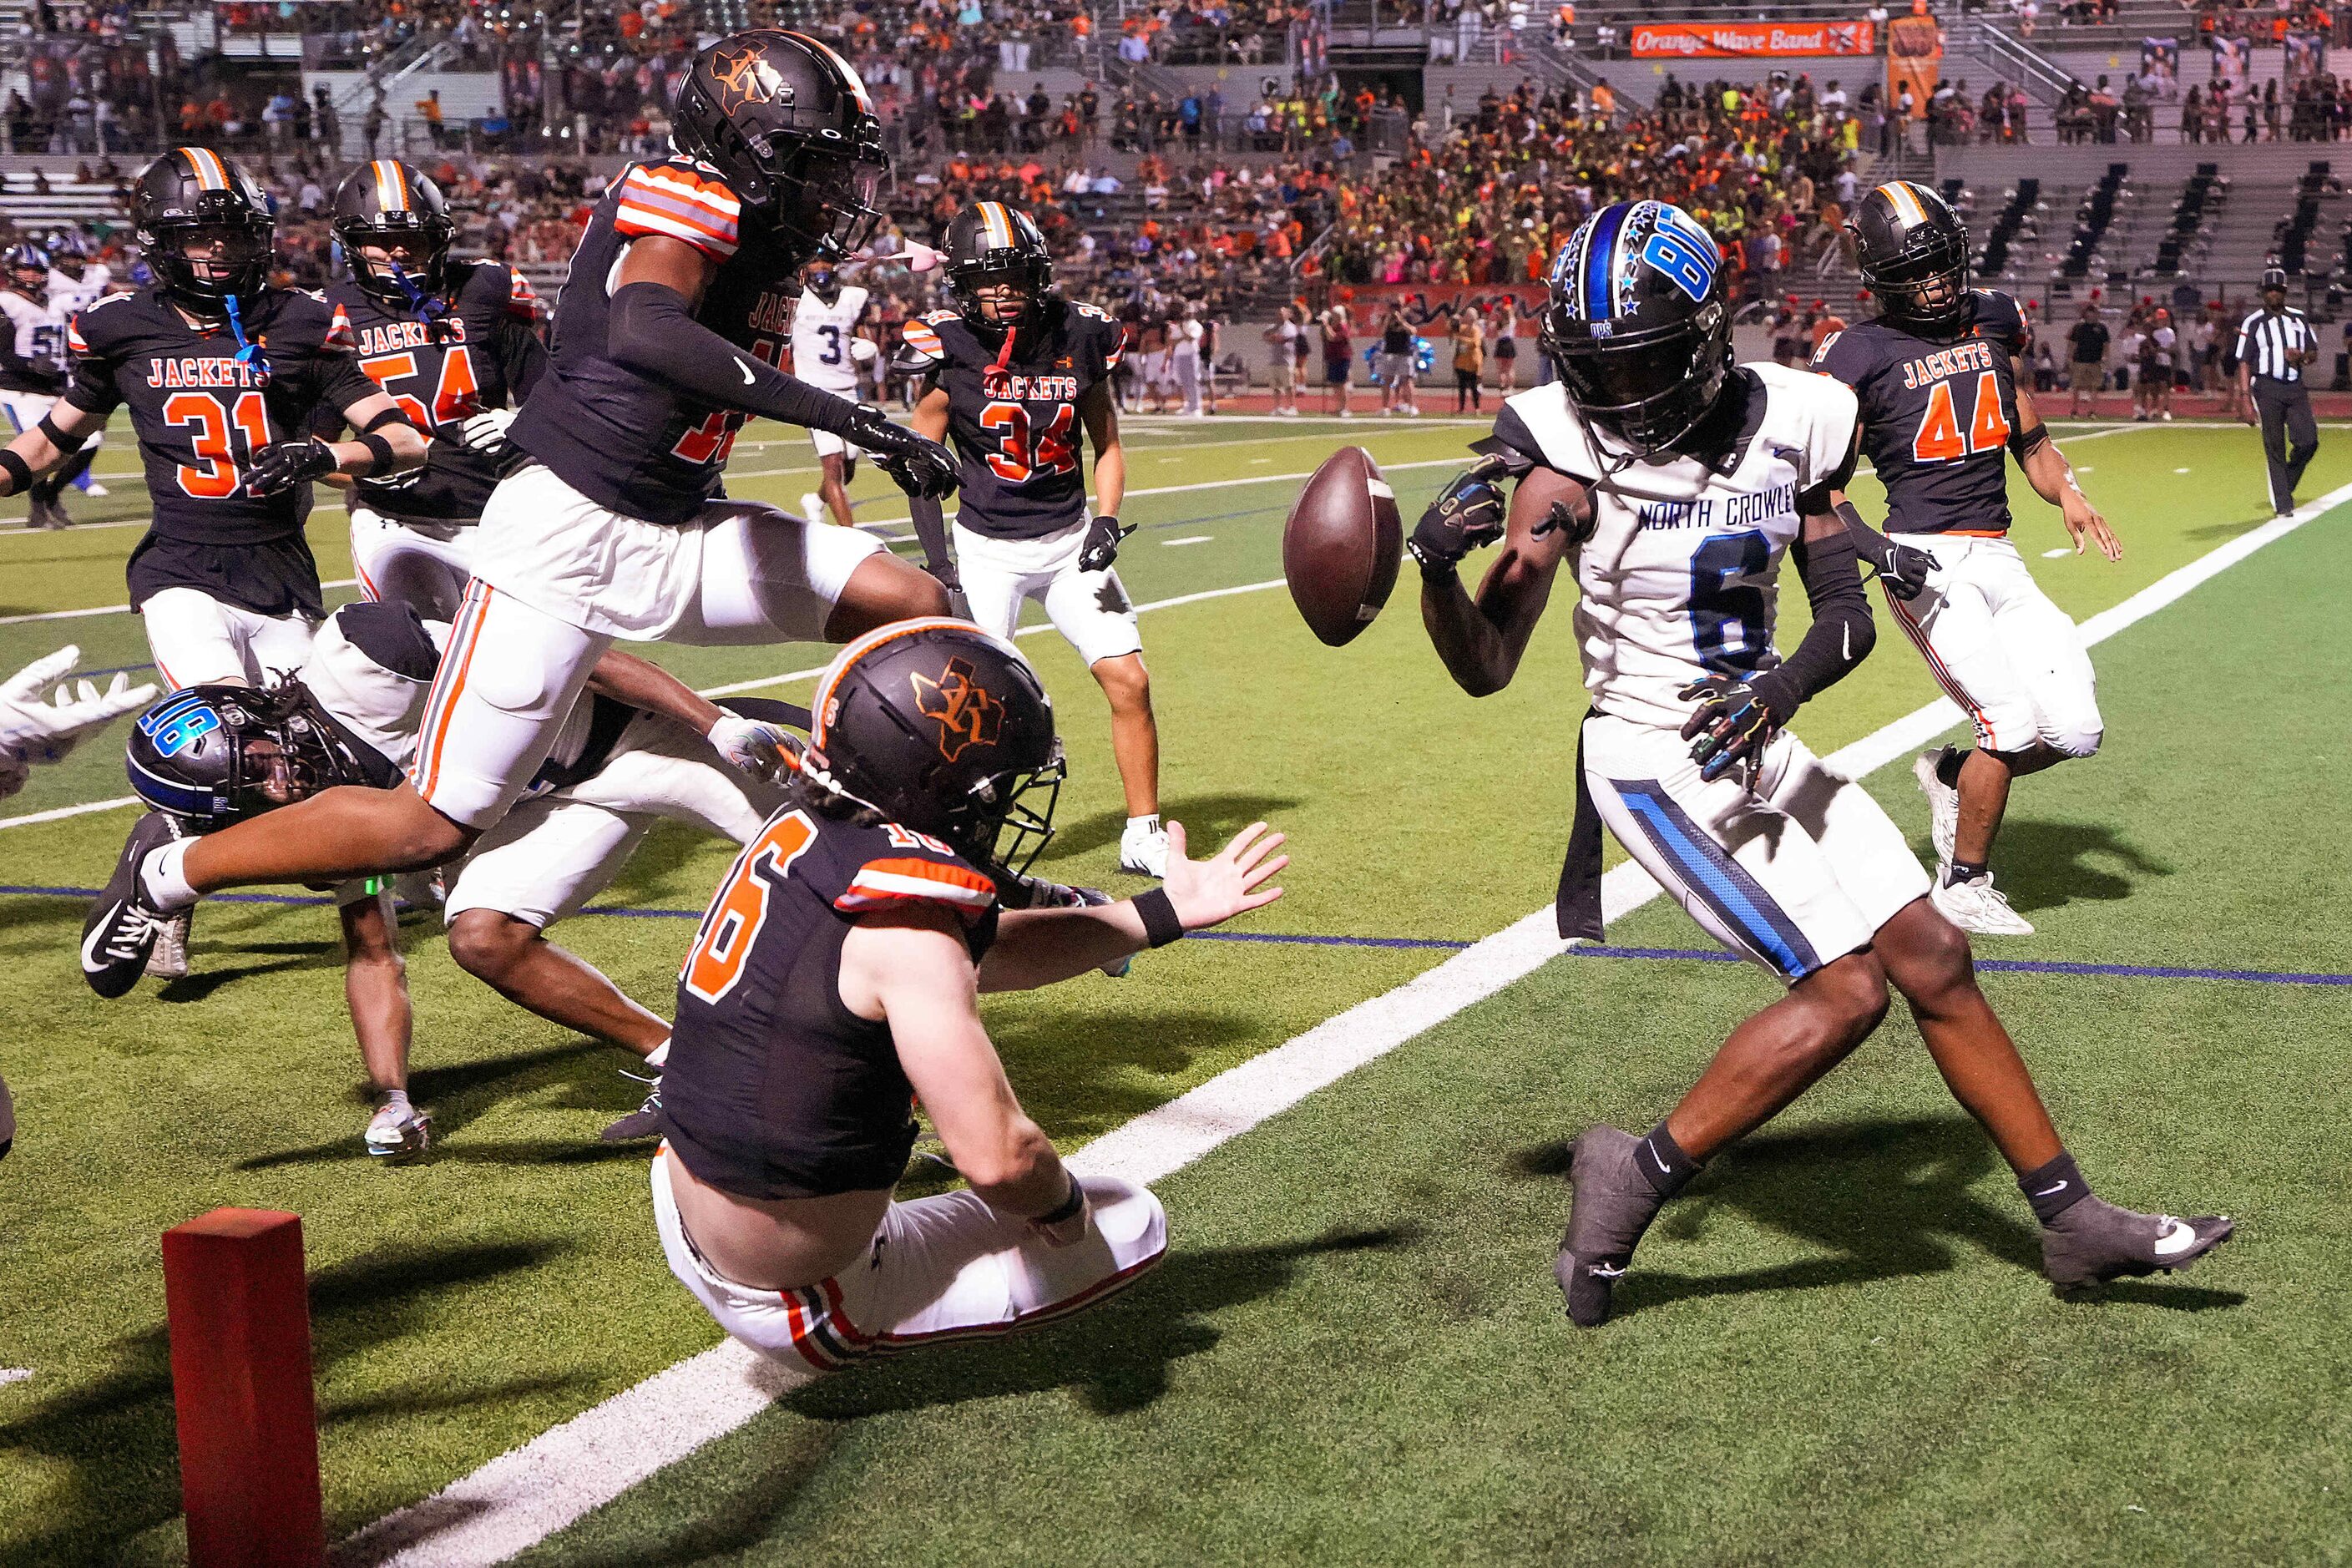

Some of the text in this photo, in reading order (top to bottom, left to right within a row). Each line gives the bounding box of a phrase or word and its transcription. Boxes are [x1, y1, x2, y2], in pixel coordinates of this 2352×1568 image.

[1636, 29, 1823, 54] Orange Wave Band
[817, 324, 842, 366] 3
[1903, 341, 1993, 390] JACKETS
[357, 345, 478, 448] 54
[984, 375, 1077, 401] JACKETS
[1912, 370, 2011, 466] 44
[162, 391, 272, 499] 31
[979, 400, 1077, 483] 34
[1637, 500, 1712, 531] NORTH
[1690, 528, 1772, 683] 6
[679, 800, 820, 1006] 6
